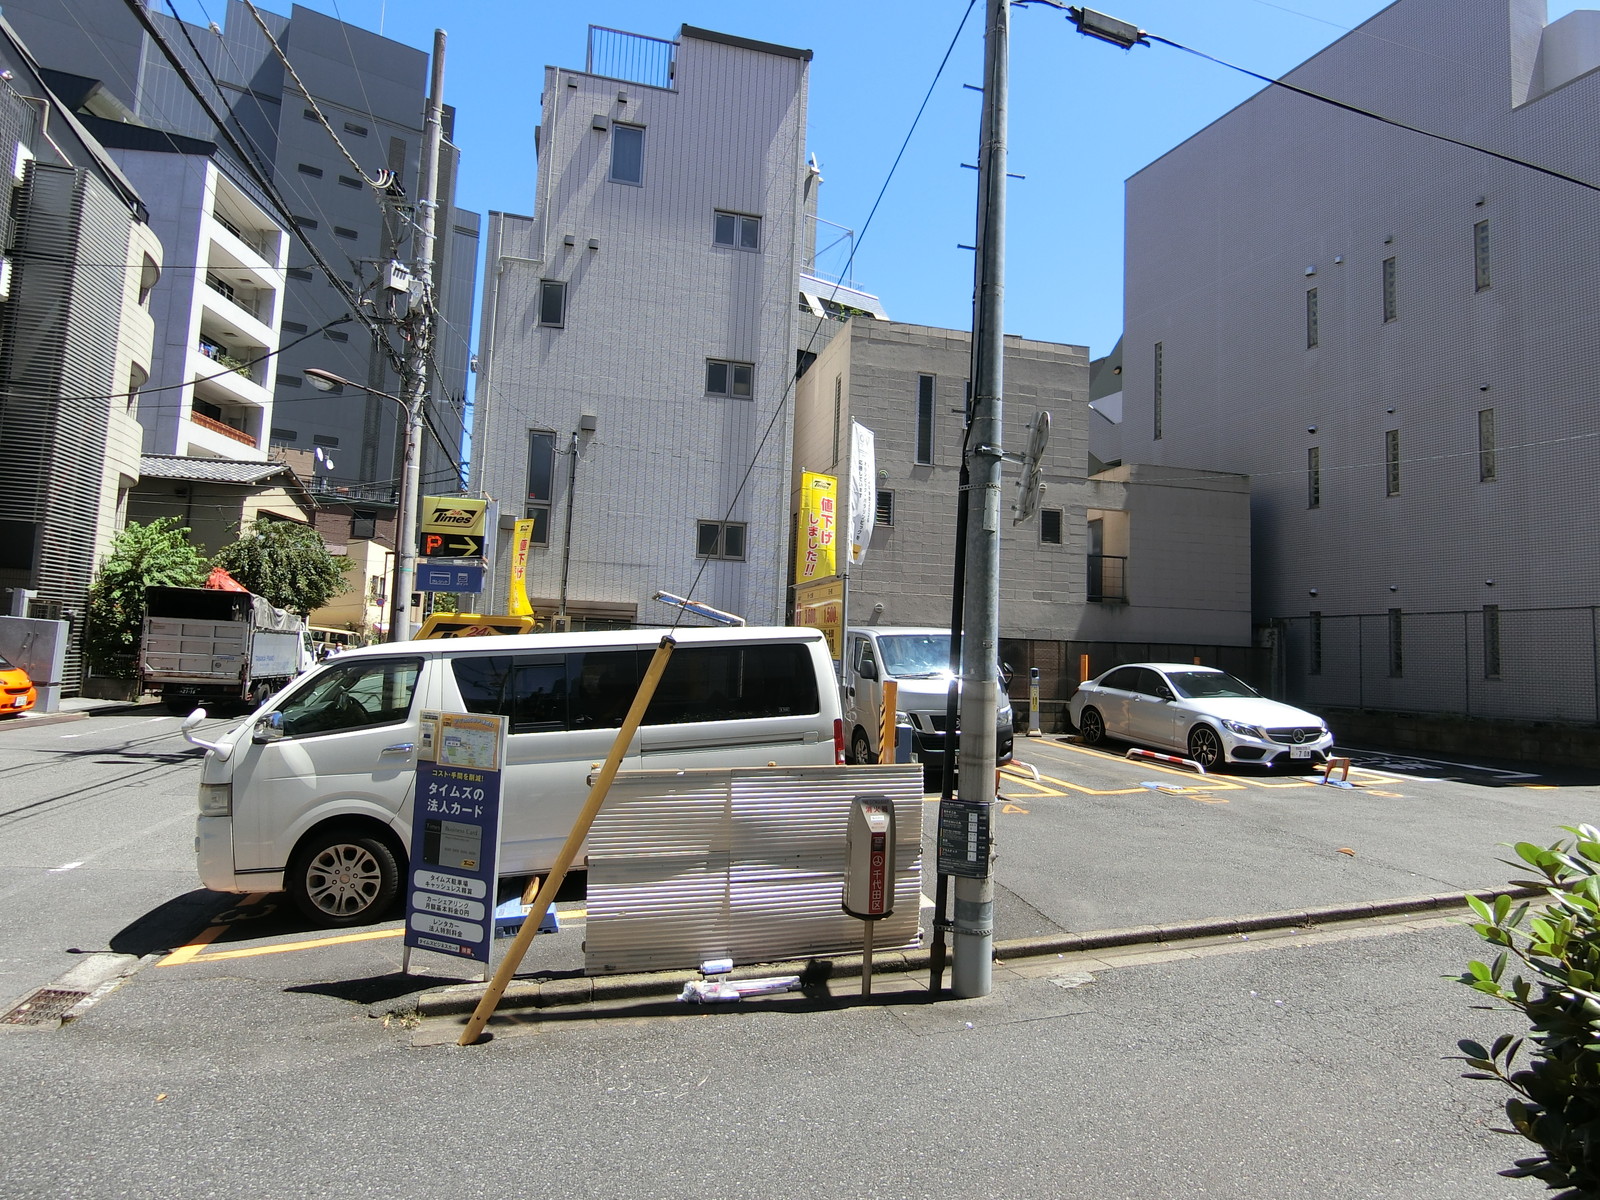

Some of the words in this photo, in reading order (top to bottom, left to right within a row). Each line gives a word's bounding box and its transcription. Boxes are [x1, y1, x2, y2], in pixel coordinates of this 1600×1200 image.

[432, 508, 473, 524] Times
[821, 498, 833, 545] 値下げ
[426, 535, 443, 555] P
[428, 782, 485, 801] タイムズの
[427, 798, 483, 818] 法人カード
[872, 869, 882, 910] 千代田区
[426, 896, 469, 909] カーシェアリング
[429, 924, 463, 938] 法人特別料金
[433, 918, 460, 928] レンタカー
